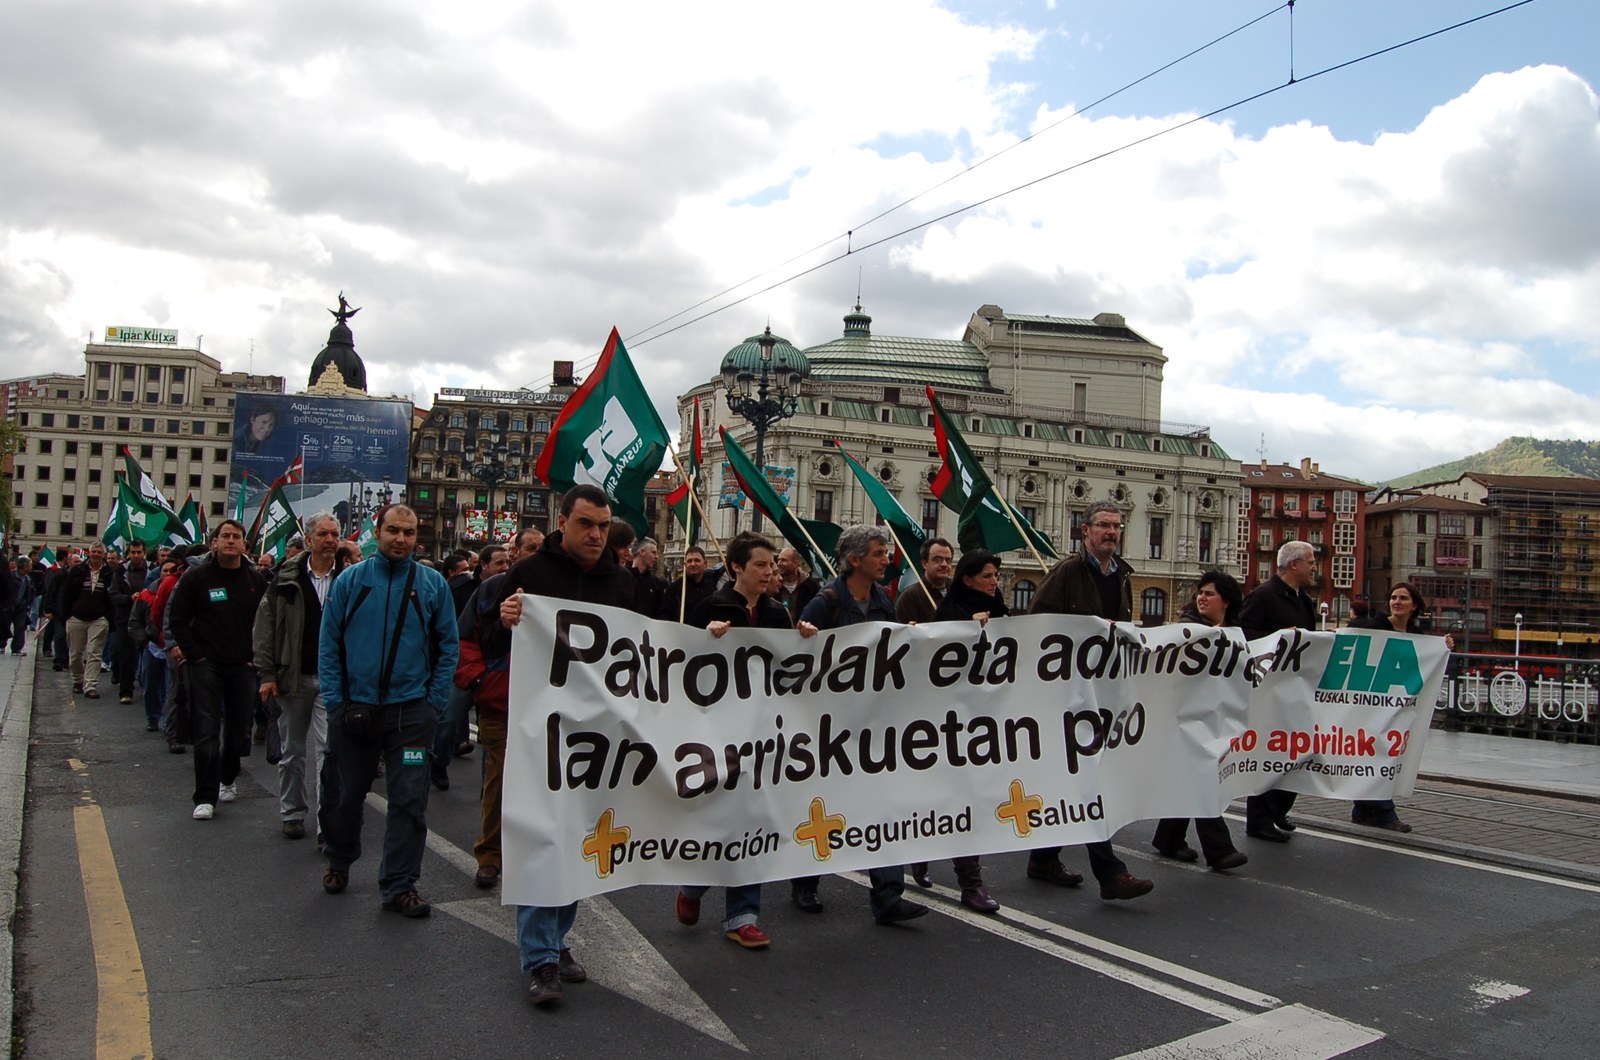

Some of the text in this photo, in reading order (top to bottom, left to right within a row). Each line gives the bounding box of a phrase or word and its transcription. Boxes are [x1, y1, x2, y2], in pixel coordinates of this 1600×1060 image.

[120, 329, 142, 343] Ipar
[443, 388, 468, 396] CAJA
[473, 389, 517, 399] LABORAL
[291, 402, 310, 412] Aquí
[293, 415, 328, 426] gehiago
[346, 413, 365, 423] más
[366, 427, 398, 436] hemen
[303, 434, 319, 446] 5%
[333, 435, 354, 445] 25%
[549, 609, 910, 707] Patronalak
[929, 629, 1018, 688] eta
[1317, 634, 1424, 696] ELA
[1314, 691, 1350, 704] EUSKAL
[1267, 724, 1376, 760] apirilak
[1387, 730, 1410, 757] 28
[404, 751, 423, 760] ELA
[547, 711, 658, 791] lan
[674, 710, 1041, 799] arriskuetan
[1239, 758, 1257, 772] eta
[609, 794, 1104, 874] prevención seguridad salud
